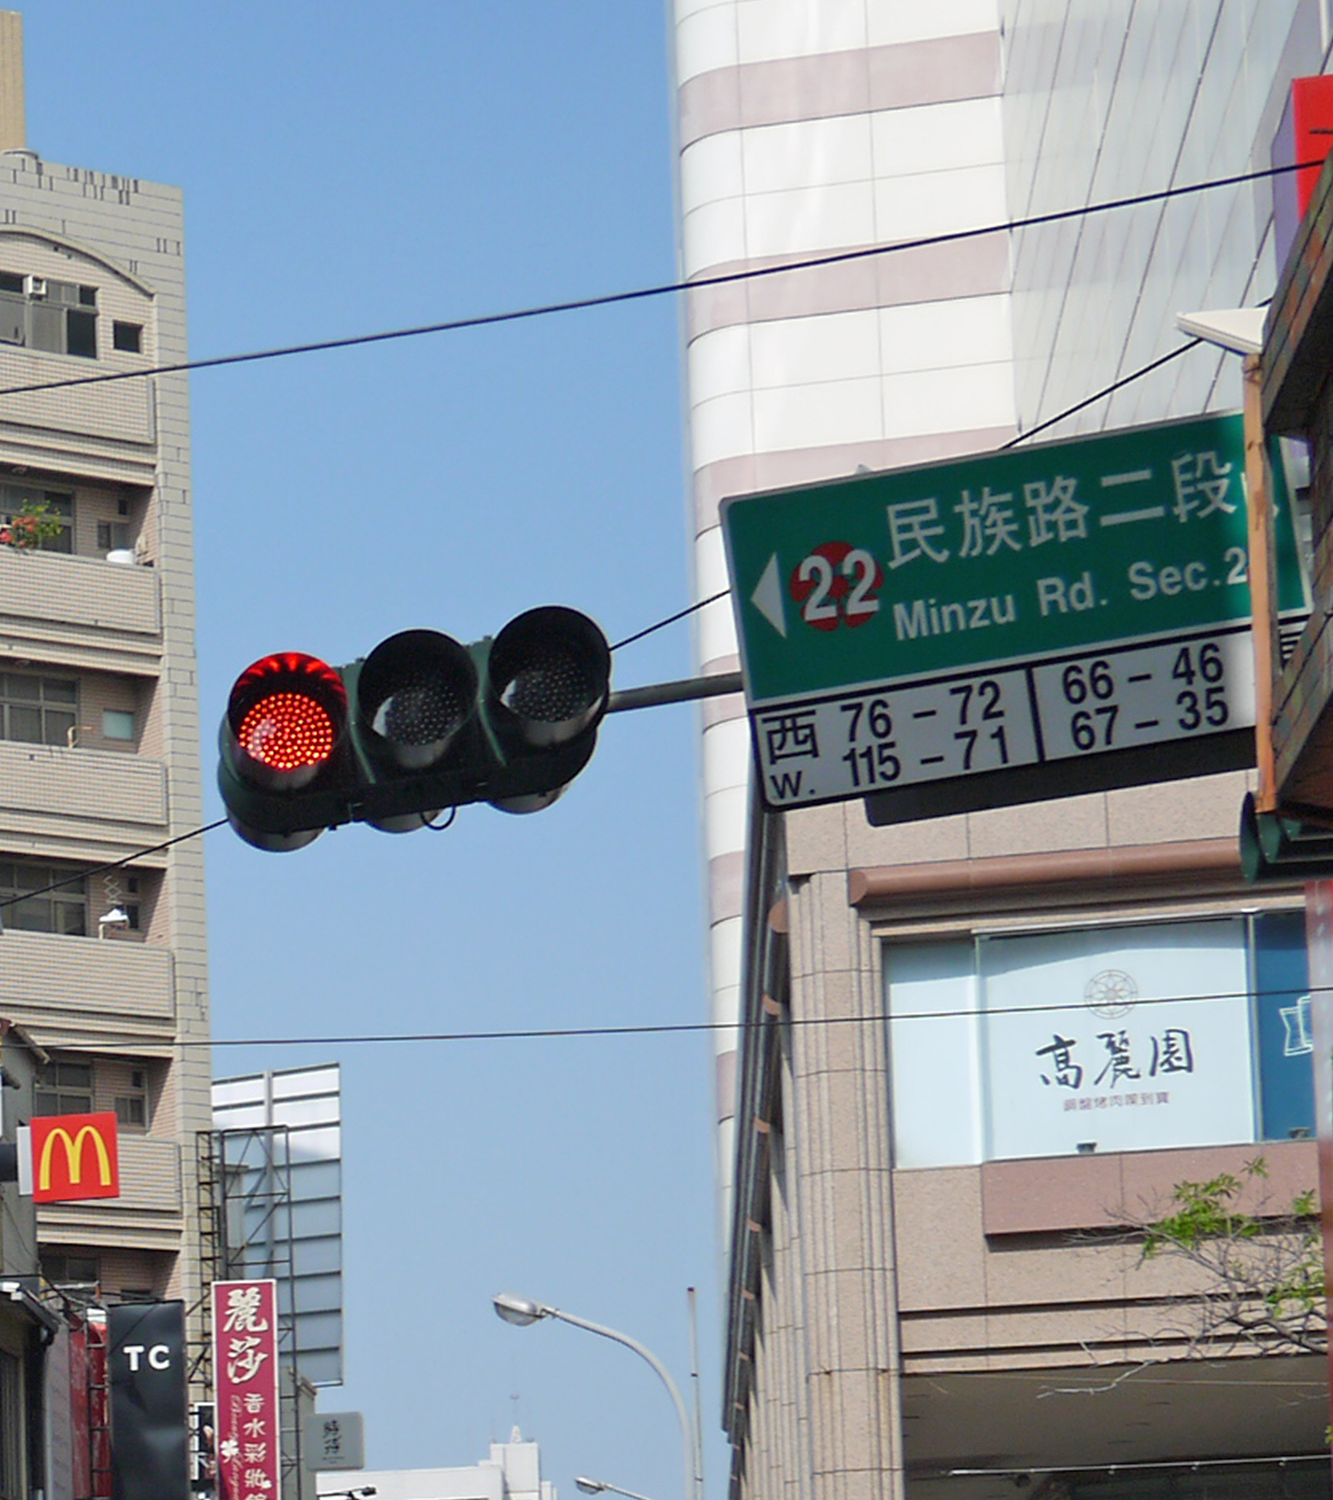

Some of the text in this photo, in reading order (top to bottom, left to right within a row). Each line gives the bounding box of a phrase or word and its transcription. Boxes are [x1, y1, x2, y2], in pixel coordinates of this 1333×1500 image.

[886, 450, 1238, 570] 民族路二段
[798, 548, 880, 623] 22
[893, 589, 1017, 642] Minzu
[1037, 572, 1108, 616] Rd.
[1061, 660, 1114, 704] 66
[1172, 643, 1223, 686] 46
[767, 709, 820, 766] 西
[840, 700, 892, 744] 76
[951, 680, 1004, 725] 72
[1070, 706, 1119, 750] 67
[1177, 686, 1229, 730] 35
[770, 771, 816, 800] W.
[841, 742, 900, 788] 115
[954, 730, 1008, 770] 71
[1036, 1028, 1193, 1088] 高麗園
[124, 1345, 170, 1371] TC
[222, 1287, 268, 1384] 麗莎
